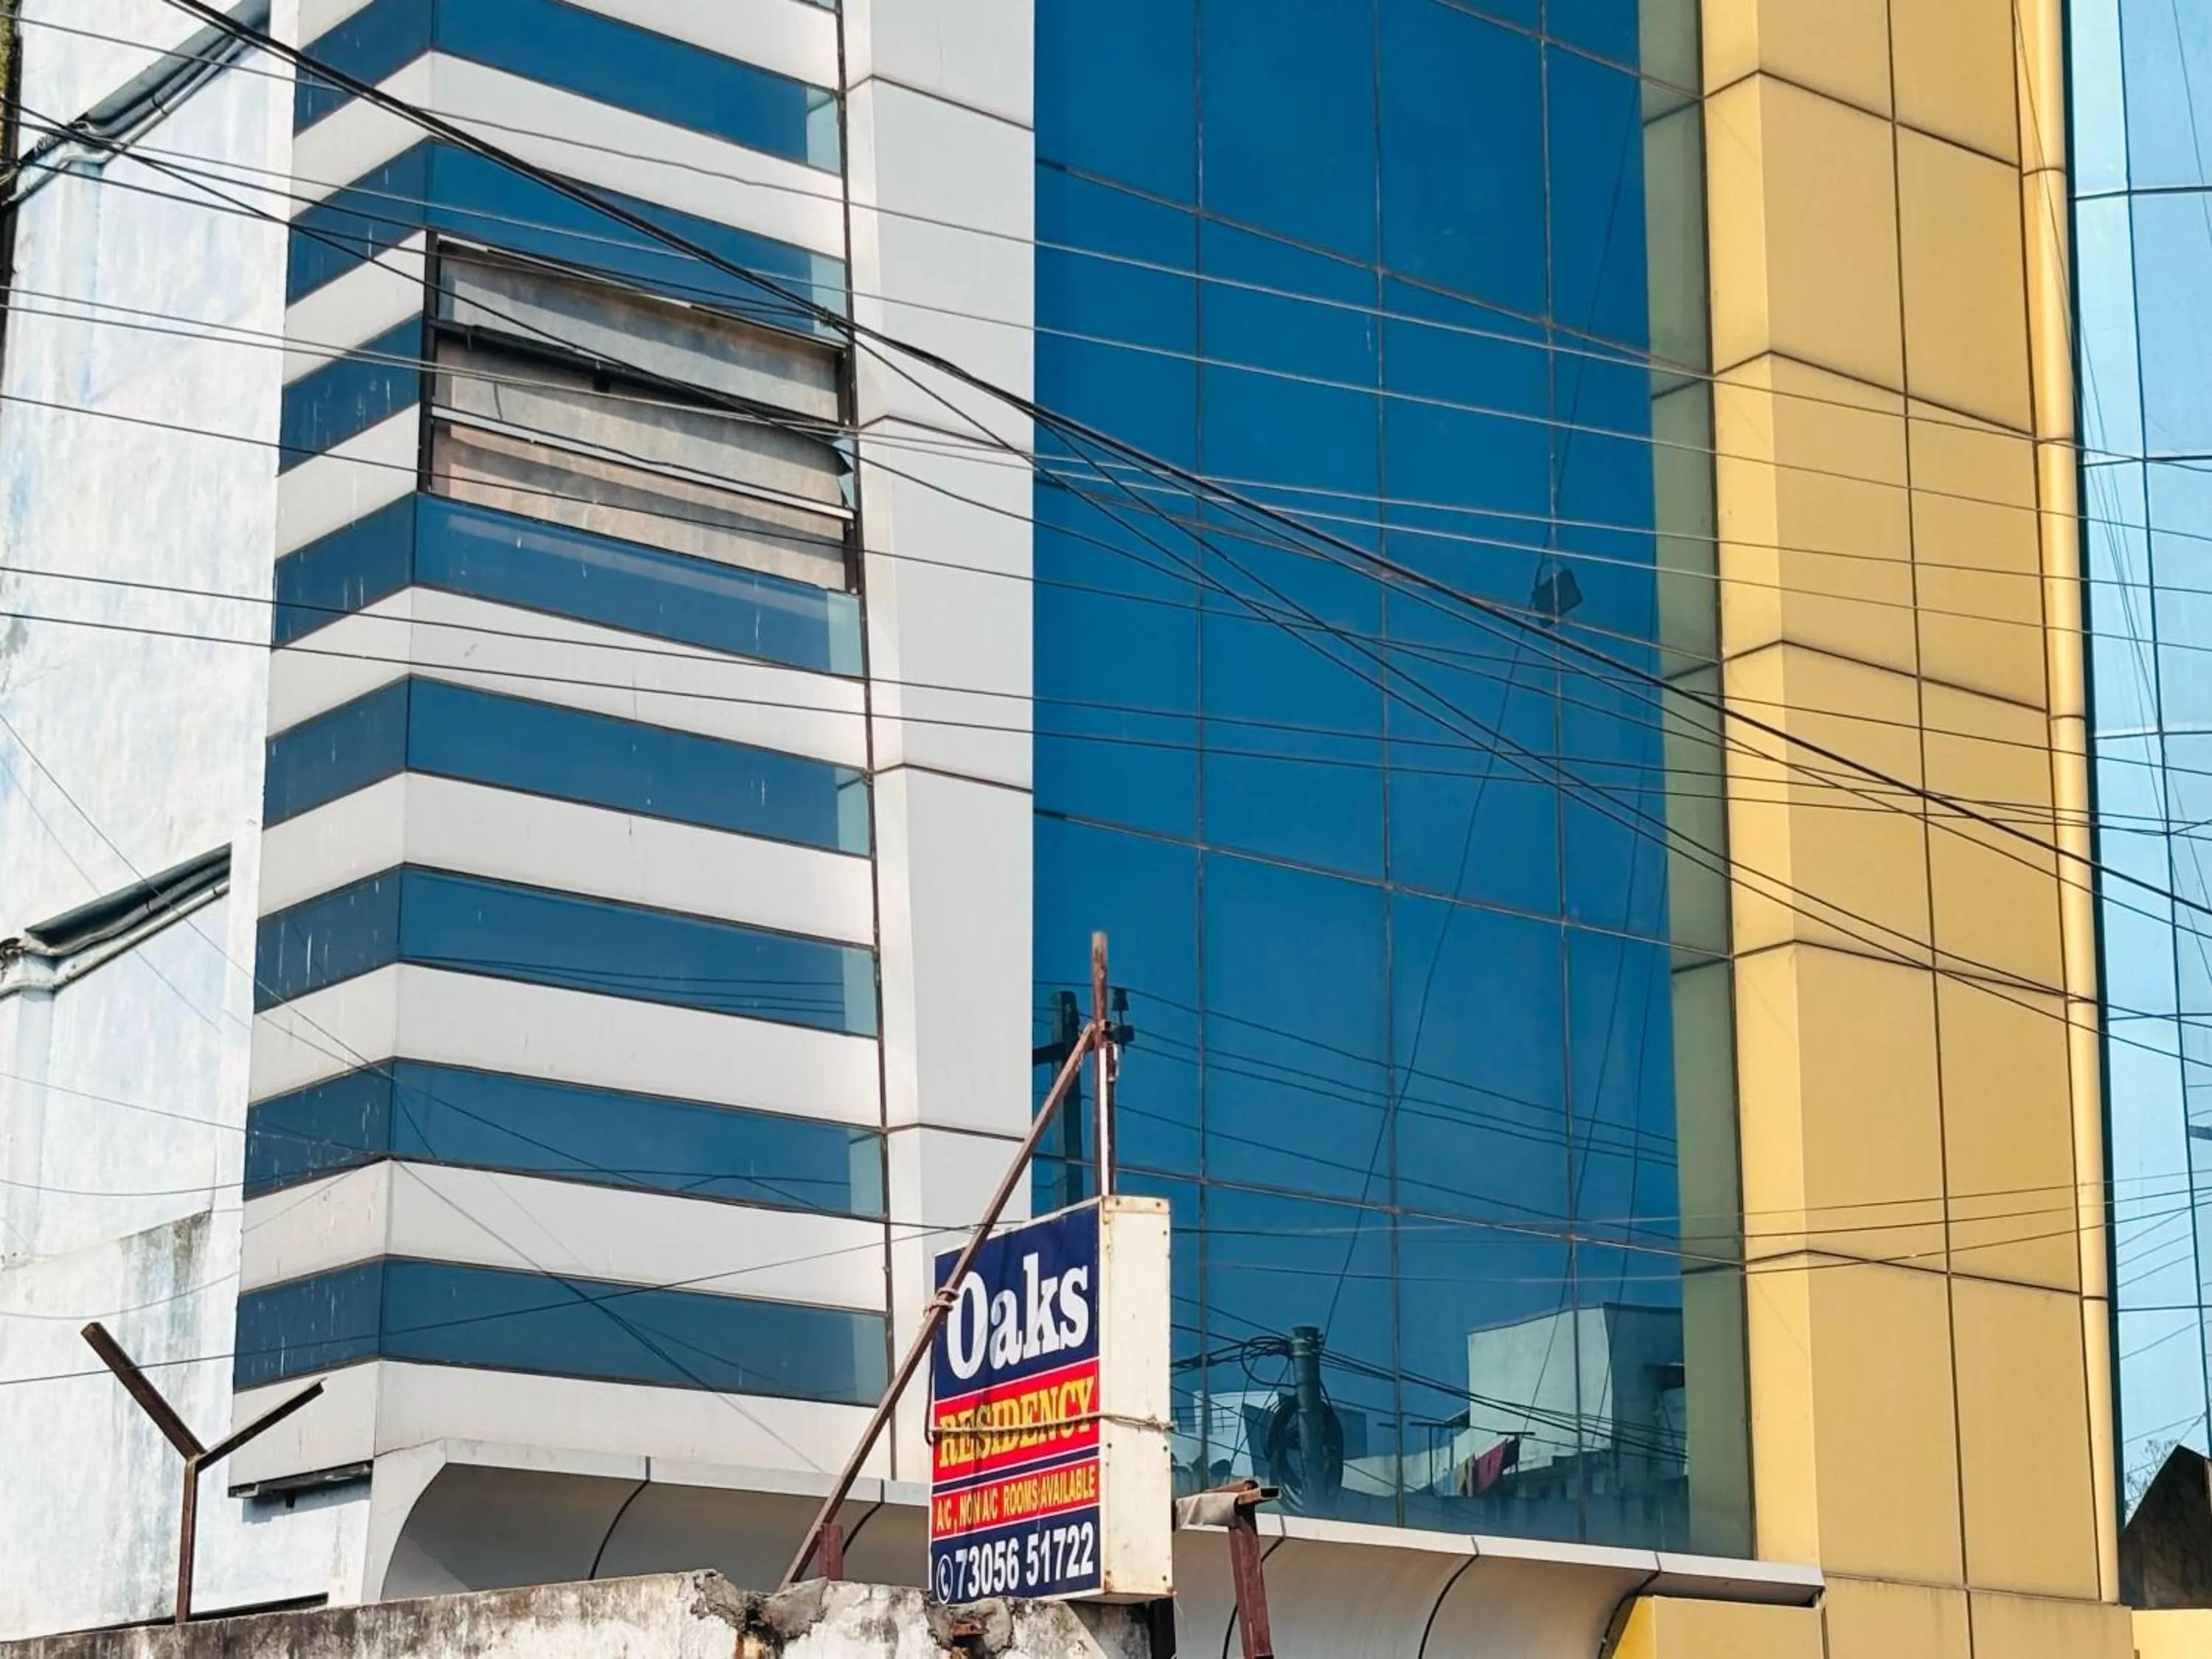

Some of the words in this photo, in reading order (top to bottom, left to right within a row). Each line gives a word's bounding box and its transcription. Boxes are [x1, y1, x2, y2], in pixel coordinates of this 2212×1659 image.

[947, 1252, 1089, 1380] Oaks
[939, 1376, 1095, 1468] RESIDENCY
[959, 1491, 980, 1527] NON
[1003, 1478, 1039, 1517] ROOMS
[1040, 1464, 1096, 1509] AVAILABLE
[955, 1537, 1020, 1599] 73056
[1026, 1521, 1094, 1586] 51722
